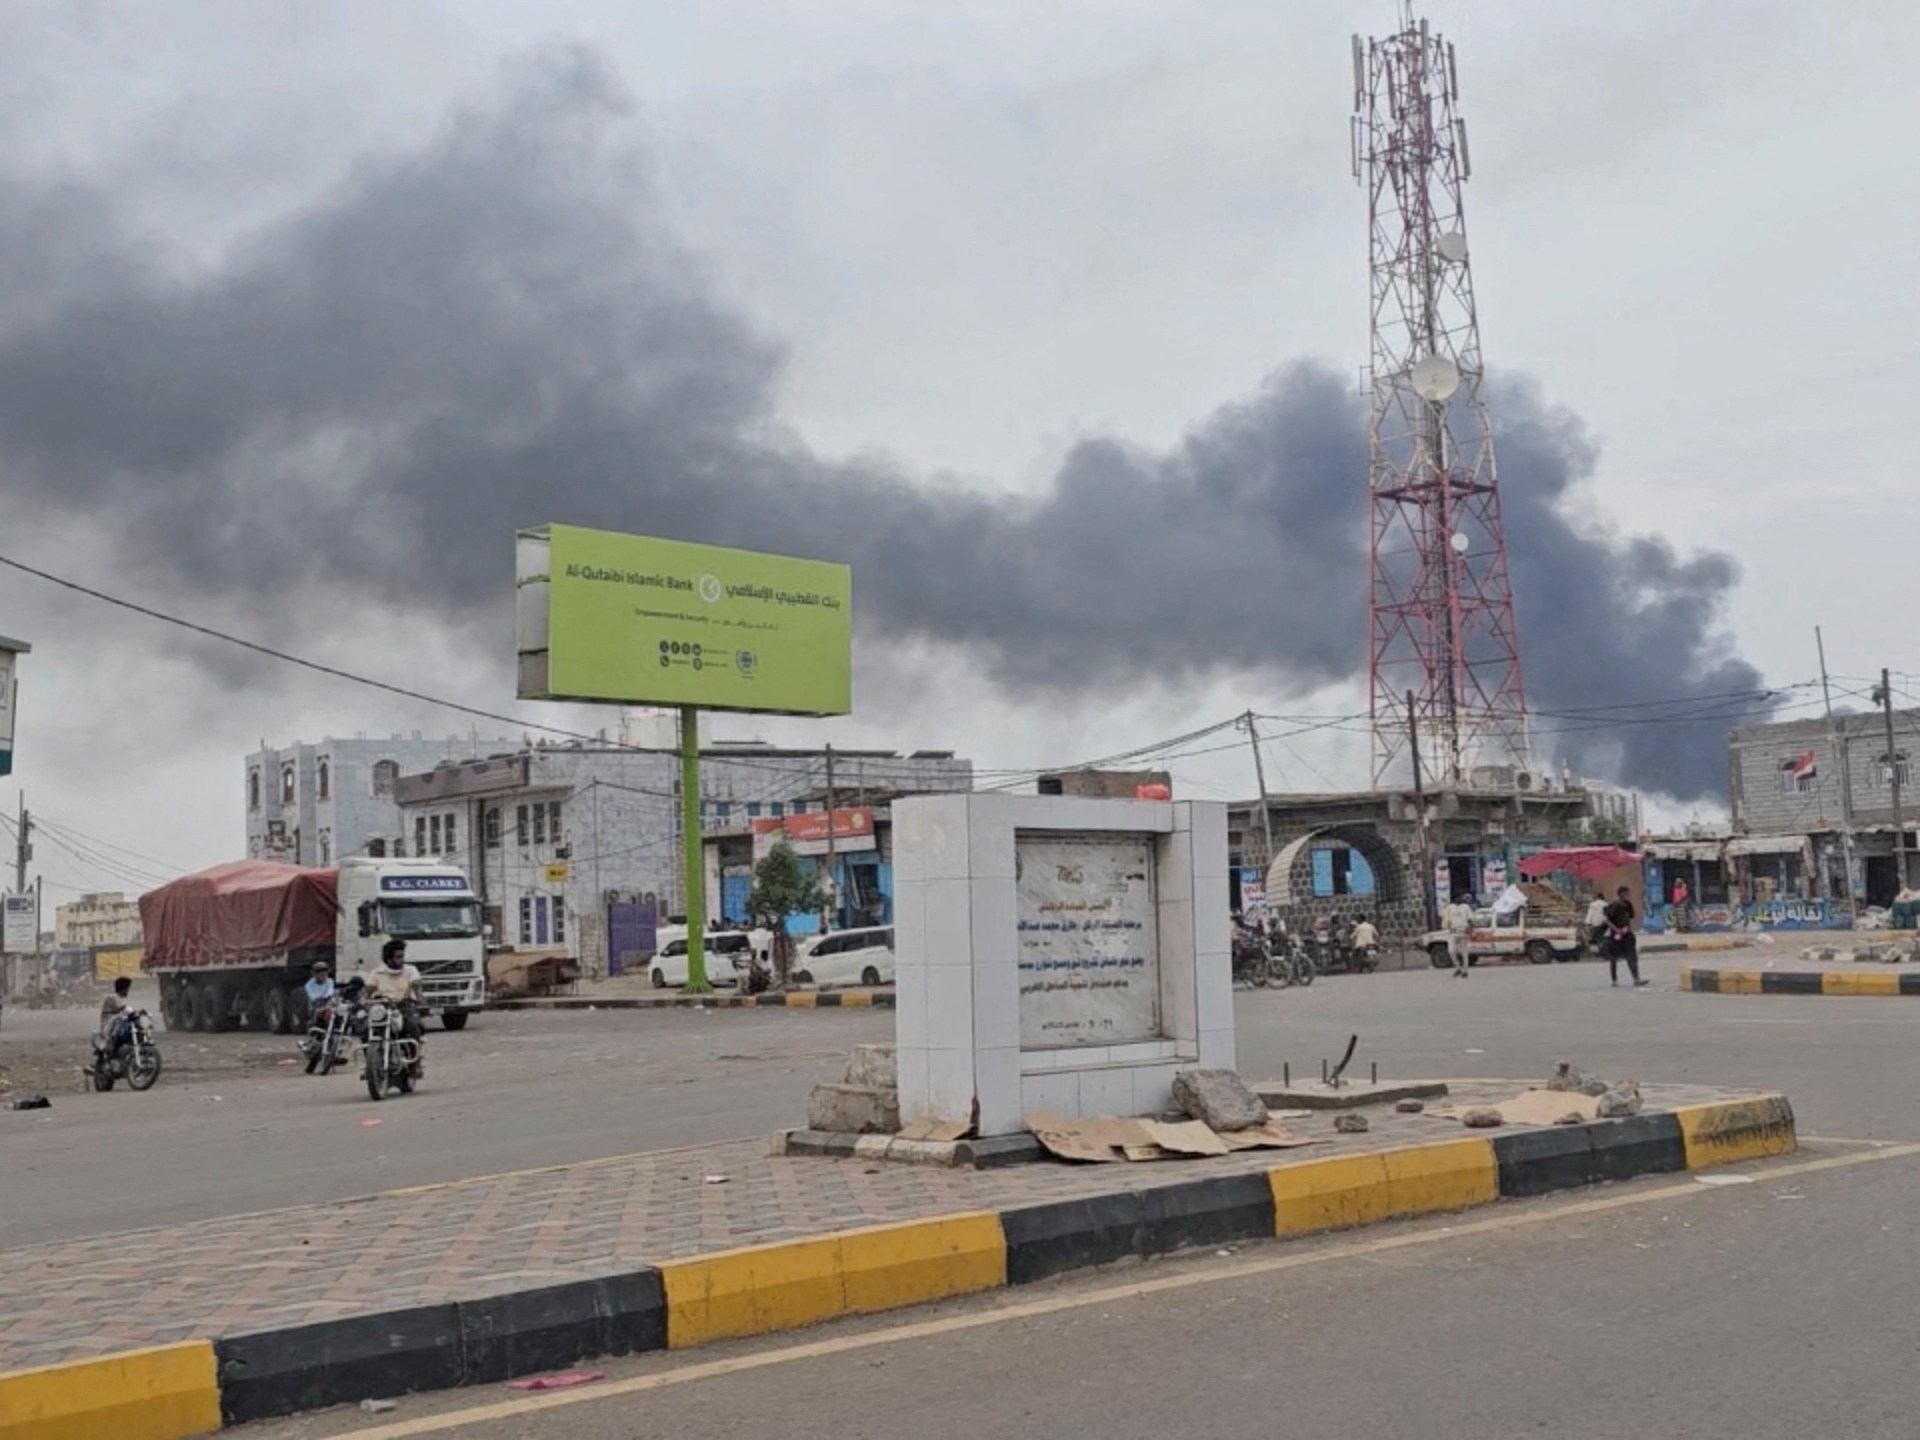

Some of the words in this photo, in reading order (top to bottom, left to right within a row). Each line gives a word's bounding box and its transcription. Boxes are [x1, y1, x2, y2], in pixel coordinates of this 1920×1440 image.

[565, 564, 625, 583] Al-Qutaibi
[626, 571, 664, 588] Islamic
[667, 576, 693, 591] Bank
[821, 595, 841, 611] بنك
